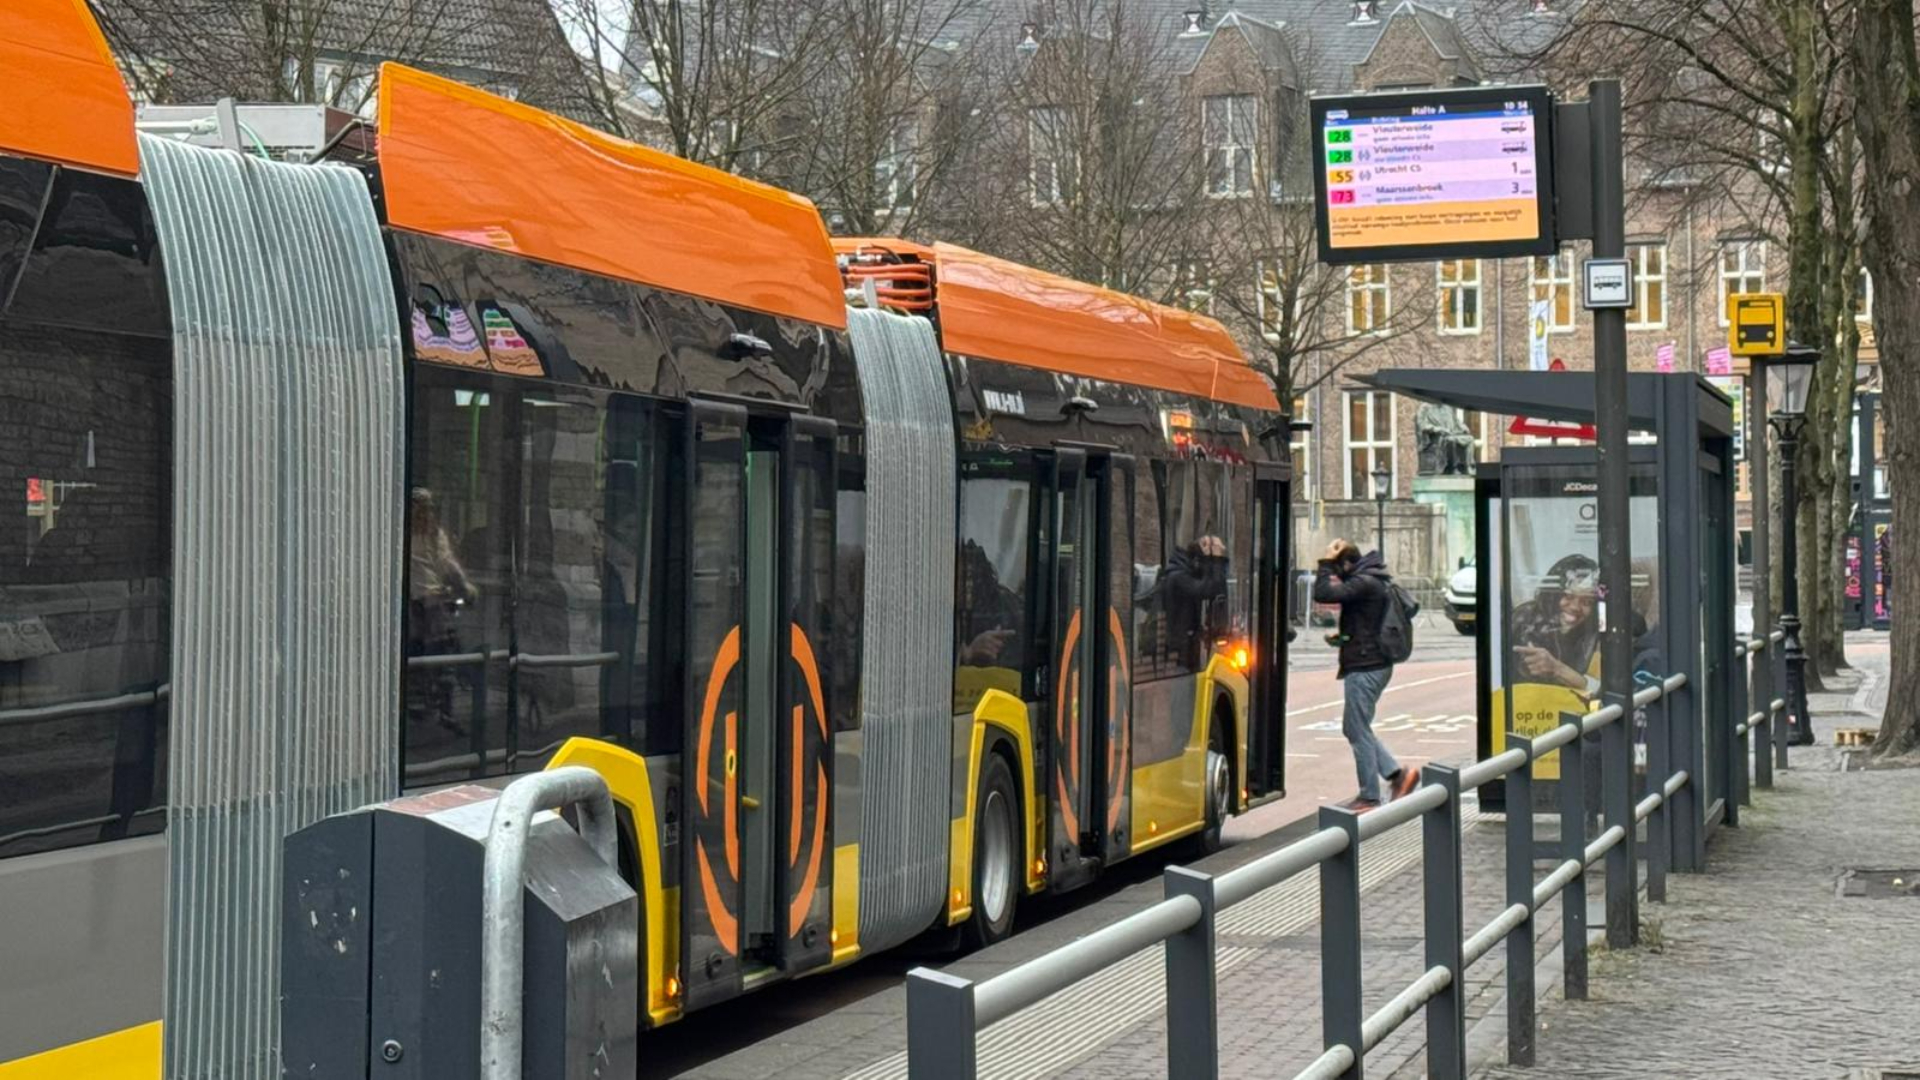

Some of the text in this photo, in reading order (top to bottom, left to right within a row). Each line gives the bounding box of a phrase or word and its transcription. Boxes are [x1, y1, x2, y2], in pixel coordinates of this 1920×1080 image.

[1411, 104, 1447, 116] Halte A
[1372, 124, 1433, 134] Vleuterweide
[1334, 130, 1351, 143] 28
[1373, 143, 1434, 154] Vleuterweide
[1335, 150, 1352, 163] 28
[1374, 164, 1421, 175] Utrecht CS
[1511, 161, 1518, 174] 1
[1336, 170, 1353, 184] 55
[1375, 182, 1443, 194] Maarssenbroek
[1511, 182, 1519, 194] 3
[1337, 190, 1354, 204] 73
[1564, 482, 1598, 491] JCDeca
[1516, 709, 1553, 724] op de
